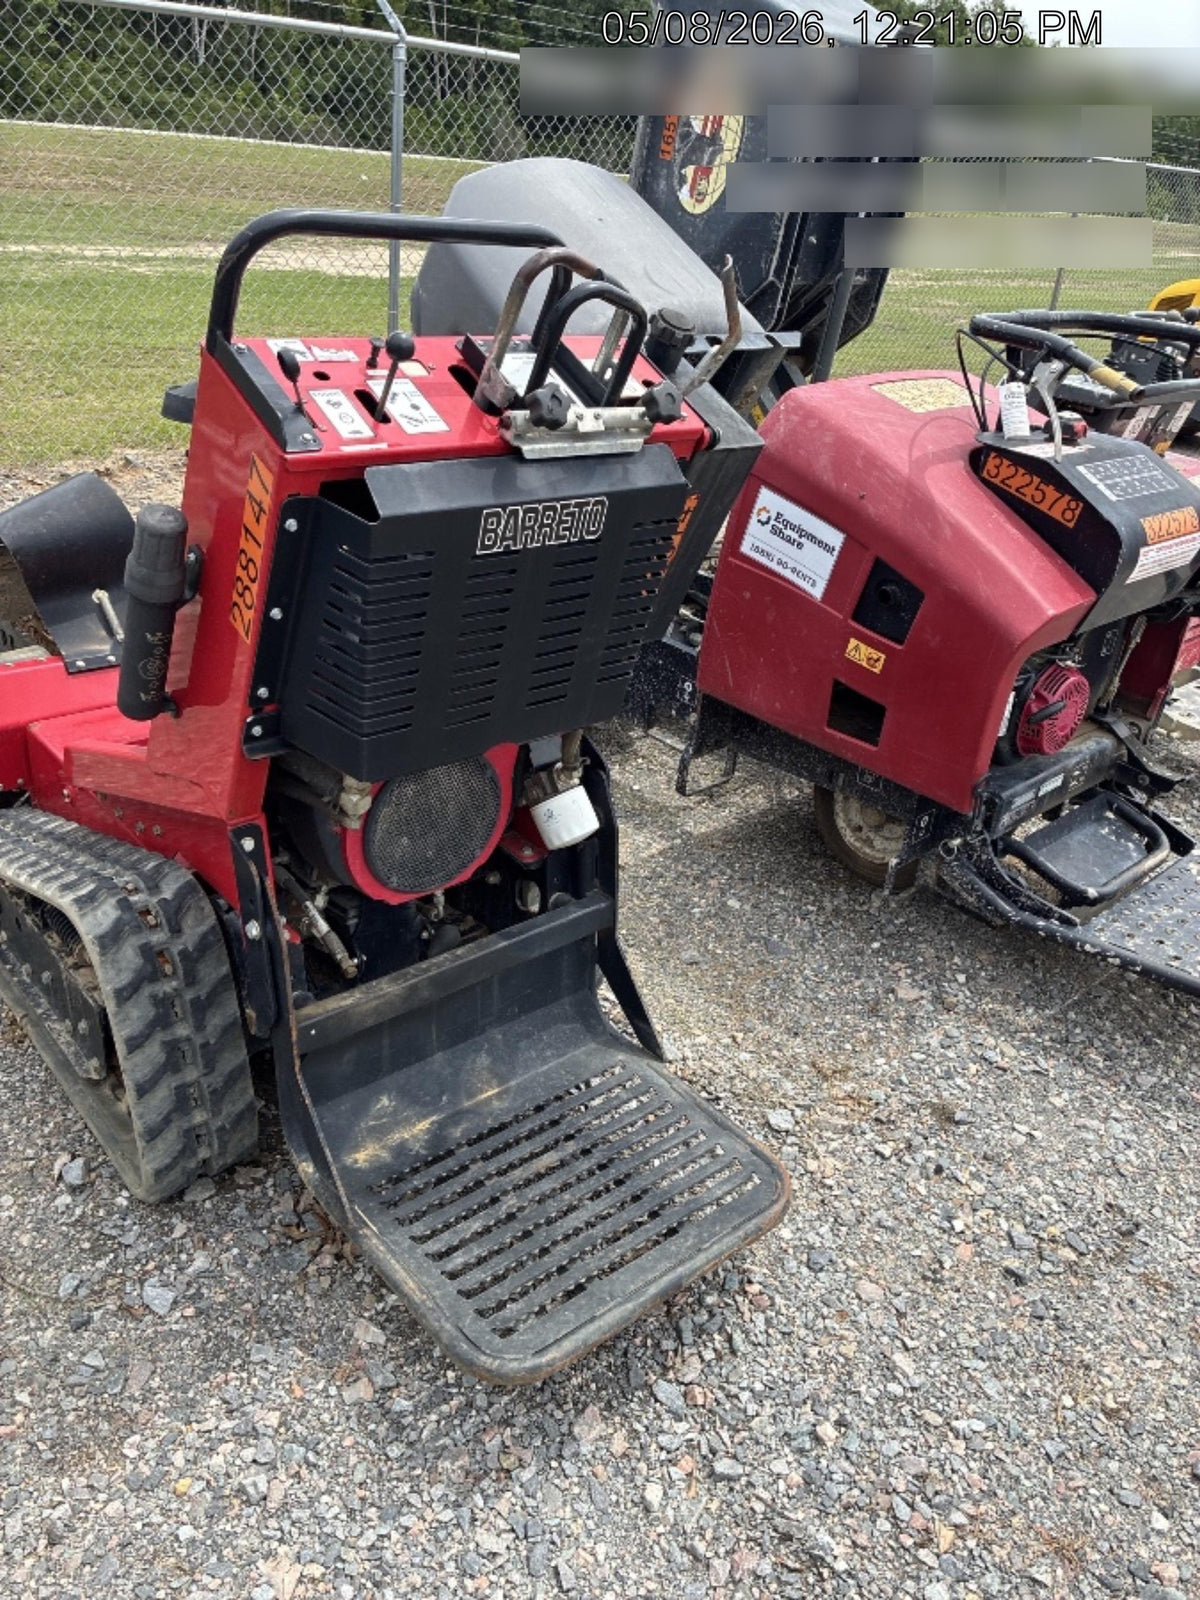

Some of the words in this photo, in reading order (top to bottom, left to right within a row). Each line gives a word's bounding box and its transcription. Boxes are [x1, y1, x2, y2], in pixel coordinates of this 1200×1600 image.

[661, 115, 676, 157] 165
[986, 455, 1080, 523] 322578
[231, 455, 270, 639] 288147
[476, 497, 608, 555] BARRETO
[769, 524, 804, 550] Share
[774, 511, 835, 557] Equipment
[1144, 507, 1199, 541] 322578
